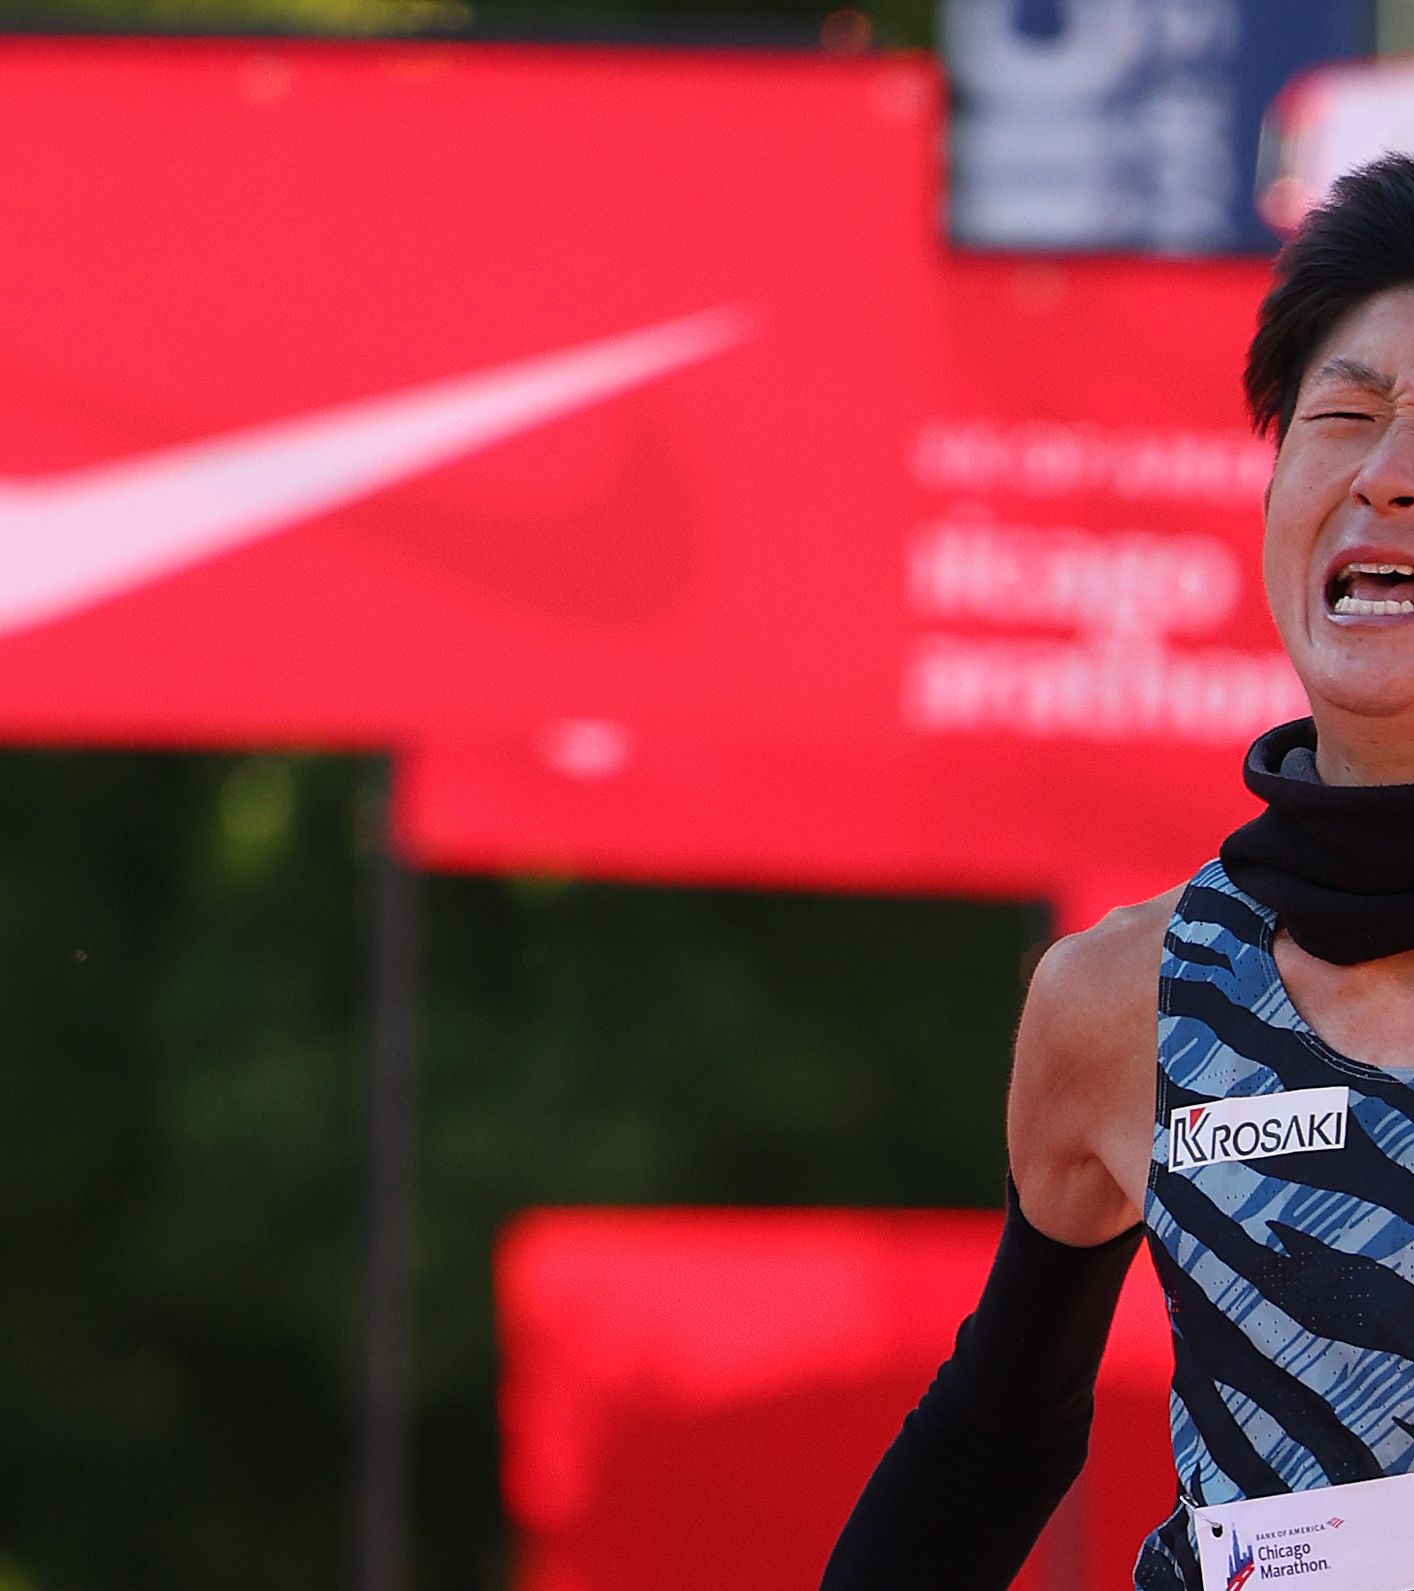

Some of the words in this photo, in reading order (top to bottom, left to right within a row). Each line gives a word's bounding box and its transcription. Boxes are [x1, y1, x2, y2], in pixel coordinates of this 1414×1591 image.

[1172, 1108, 1343, 1168] KROSAKI
[1288, 1523, 1325, 1535] AMERICA
[1258, 1543, 1311, 1561] Chicago
